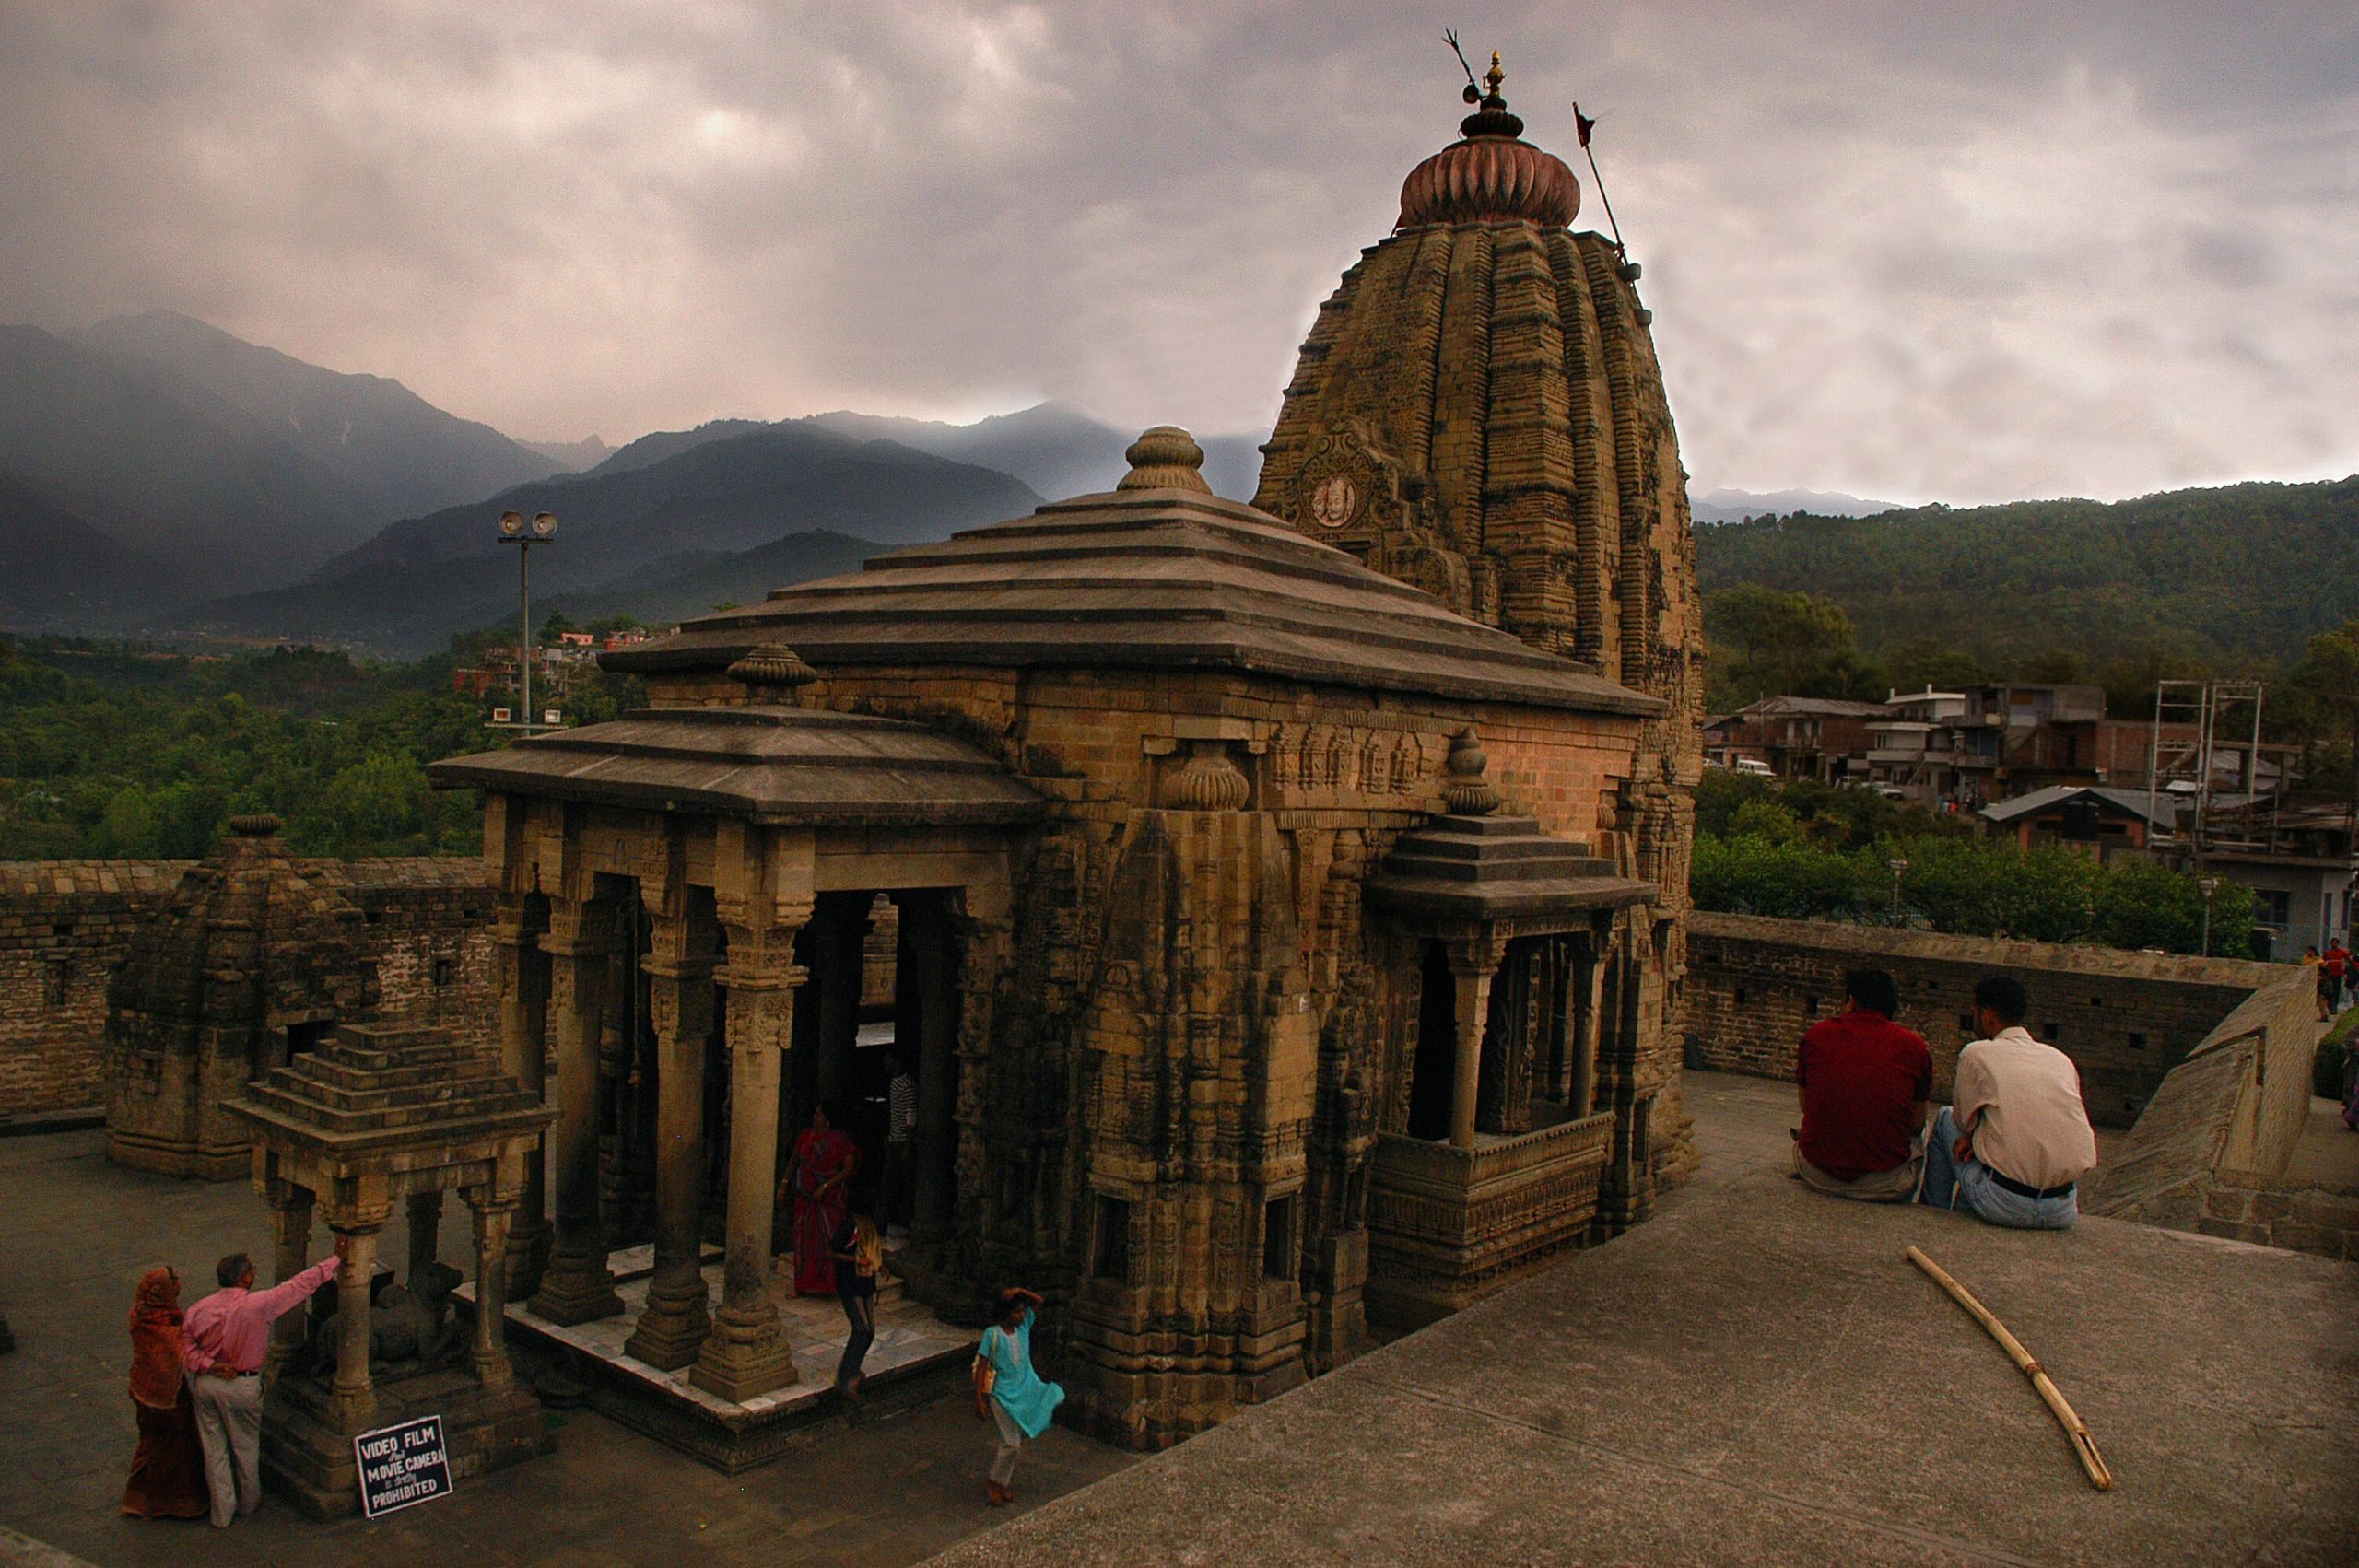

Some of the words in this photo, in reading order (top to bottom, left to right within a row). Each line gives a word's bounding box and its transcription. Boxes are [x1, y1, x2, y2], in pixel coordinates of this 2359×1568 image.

[361, 1437, 398, 1459] VIDEO
[405, 1426, 435, 1447] FILM
[367, 1461, 405, 1483] MOVIE
[405, 1449, 443, 1472] CAMERA
[372, 1479, 437, 1509] PROHIBITED
